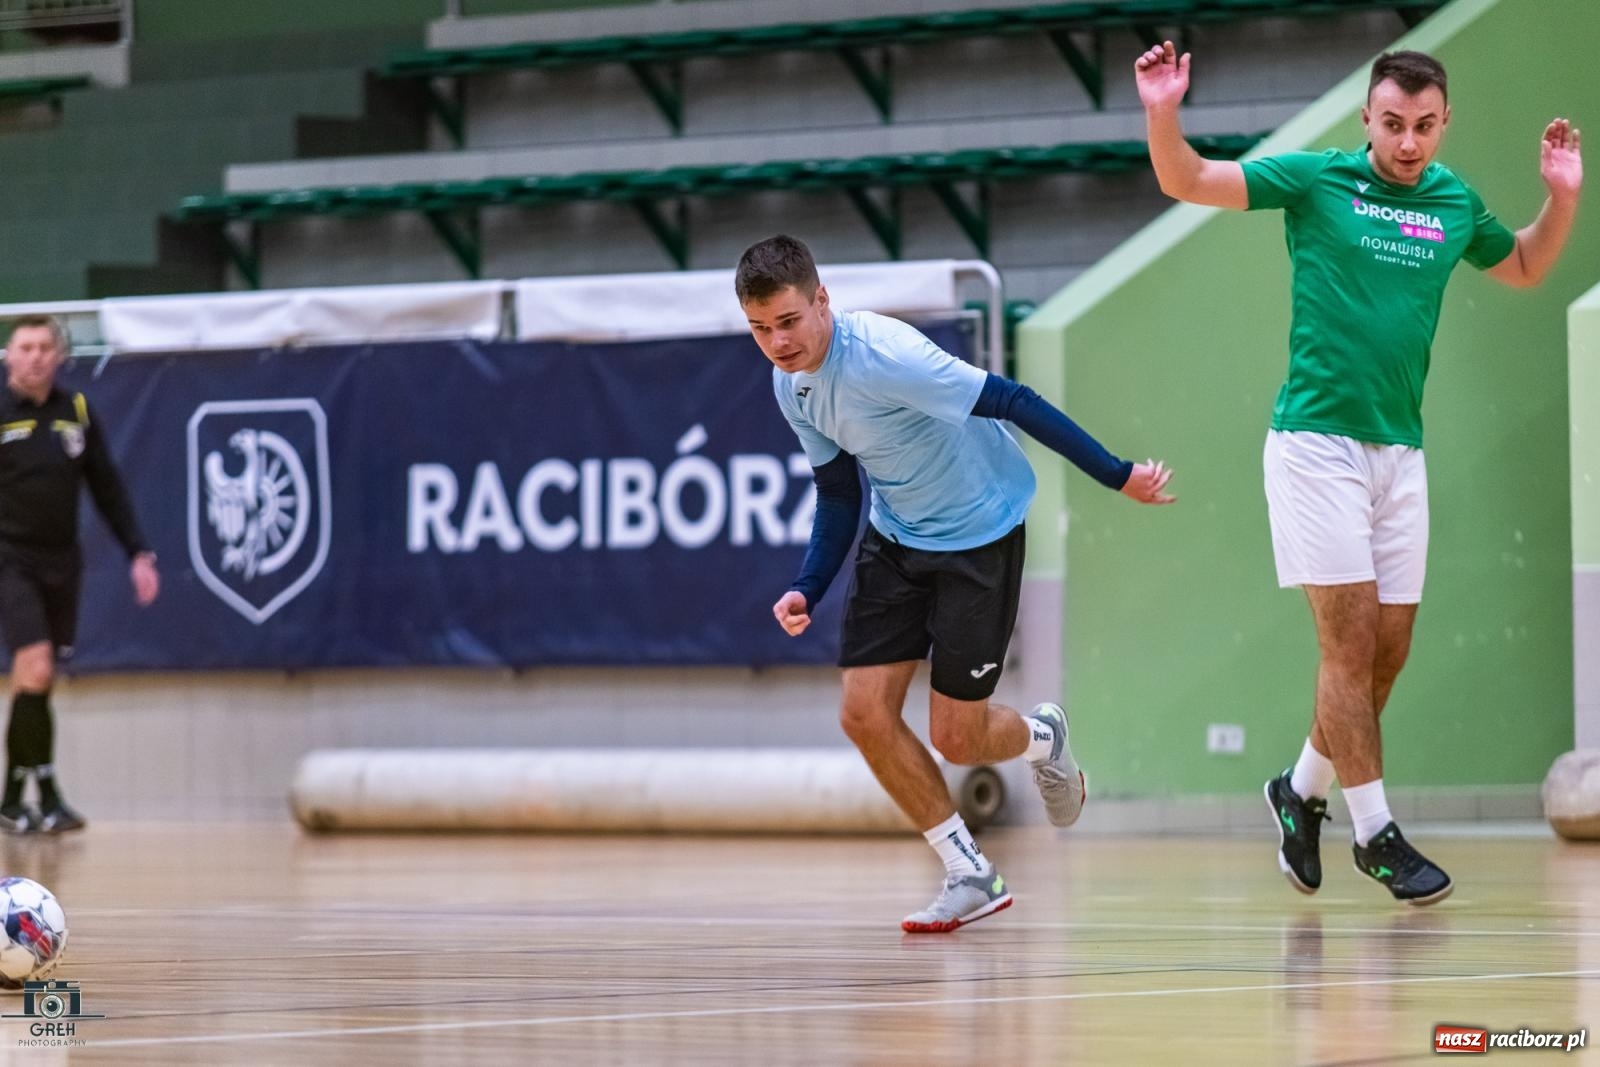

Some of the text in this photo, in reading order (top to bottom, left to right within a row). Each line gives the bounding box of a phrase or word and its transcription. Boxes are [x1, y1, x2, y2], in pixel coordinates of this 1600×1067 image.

[1354, 202, 1443, 231] DROGERIA
[1402, 226, 1443, 241] W SIECI
[1375, 253, 1400, 265] RESORT
[1408, 260, 1420, 268] SPA
